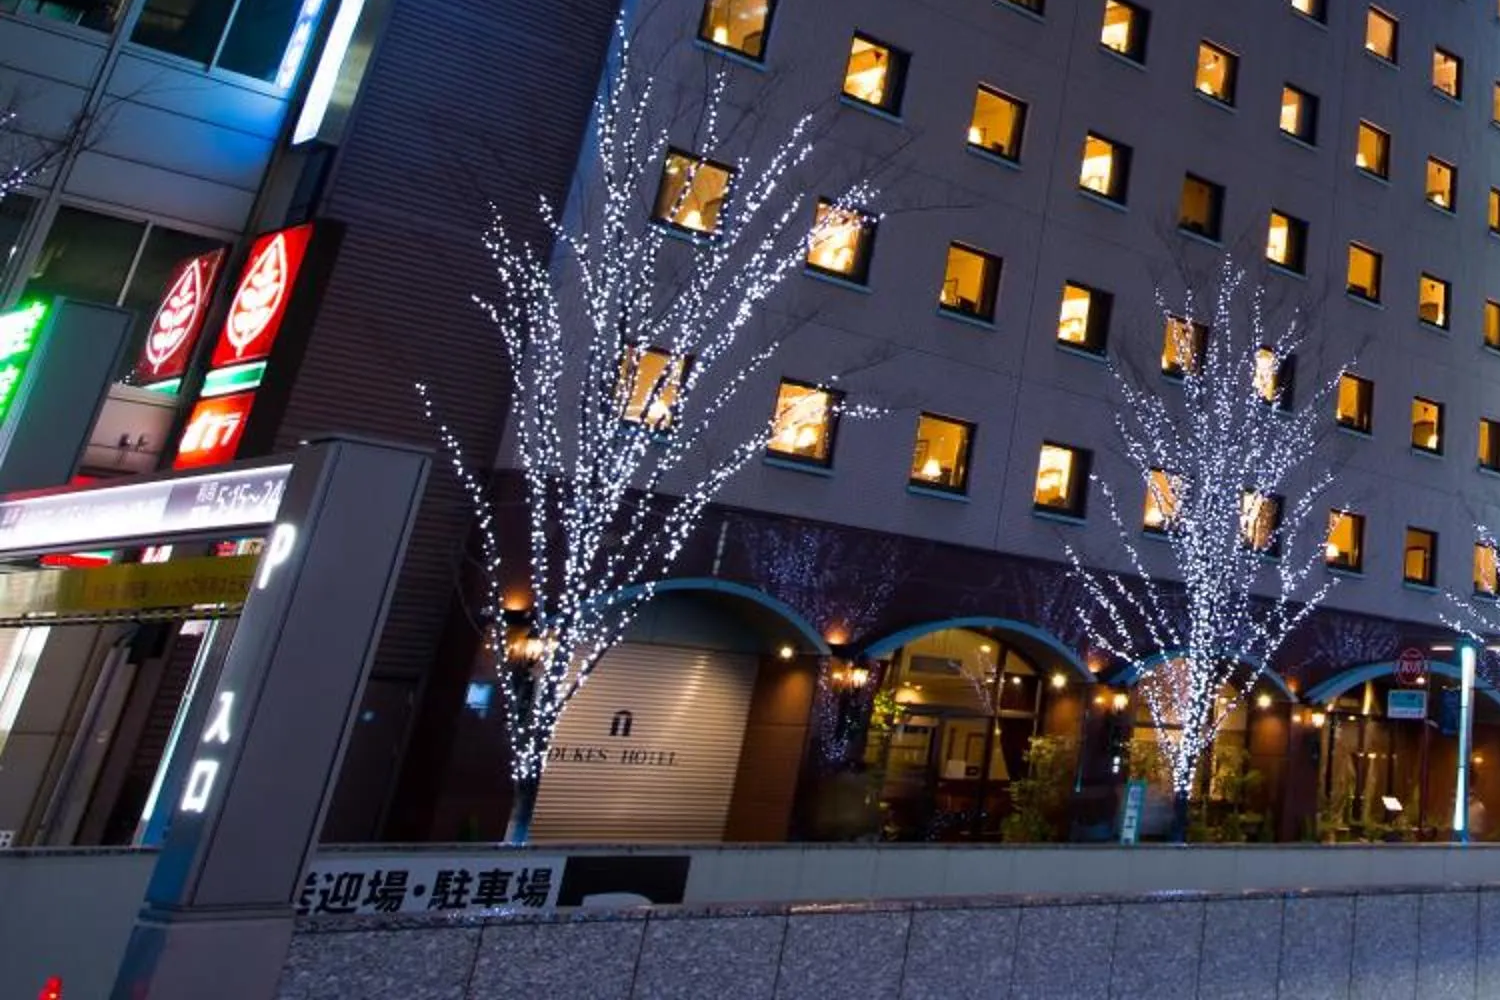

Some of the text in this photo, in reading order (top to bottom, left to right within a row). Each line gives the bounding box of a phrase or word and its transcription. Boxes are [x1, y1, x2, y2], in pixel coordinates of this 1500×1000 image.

[257, 523, 296, 589] P
[180, 690, 235, 813] 入口
[620, 749, 678, 766] HOTEL
